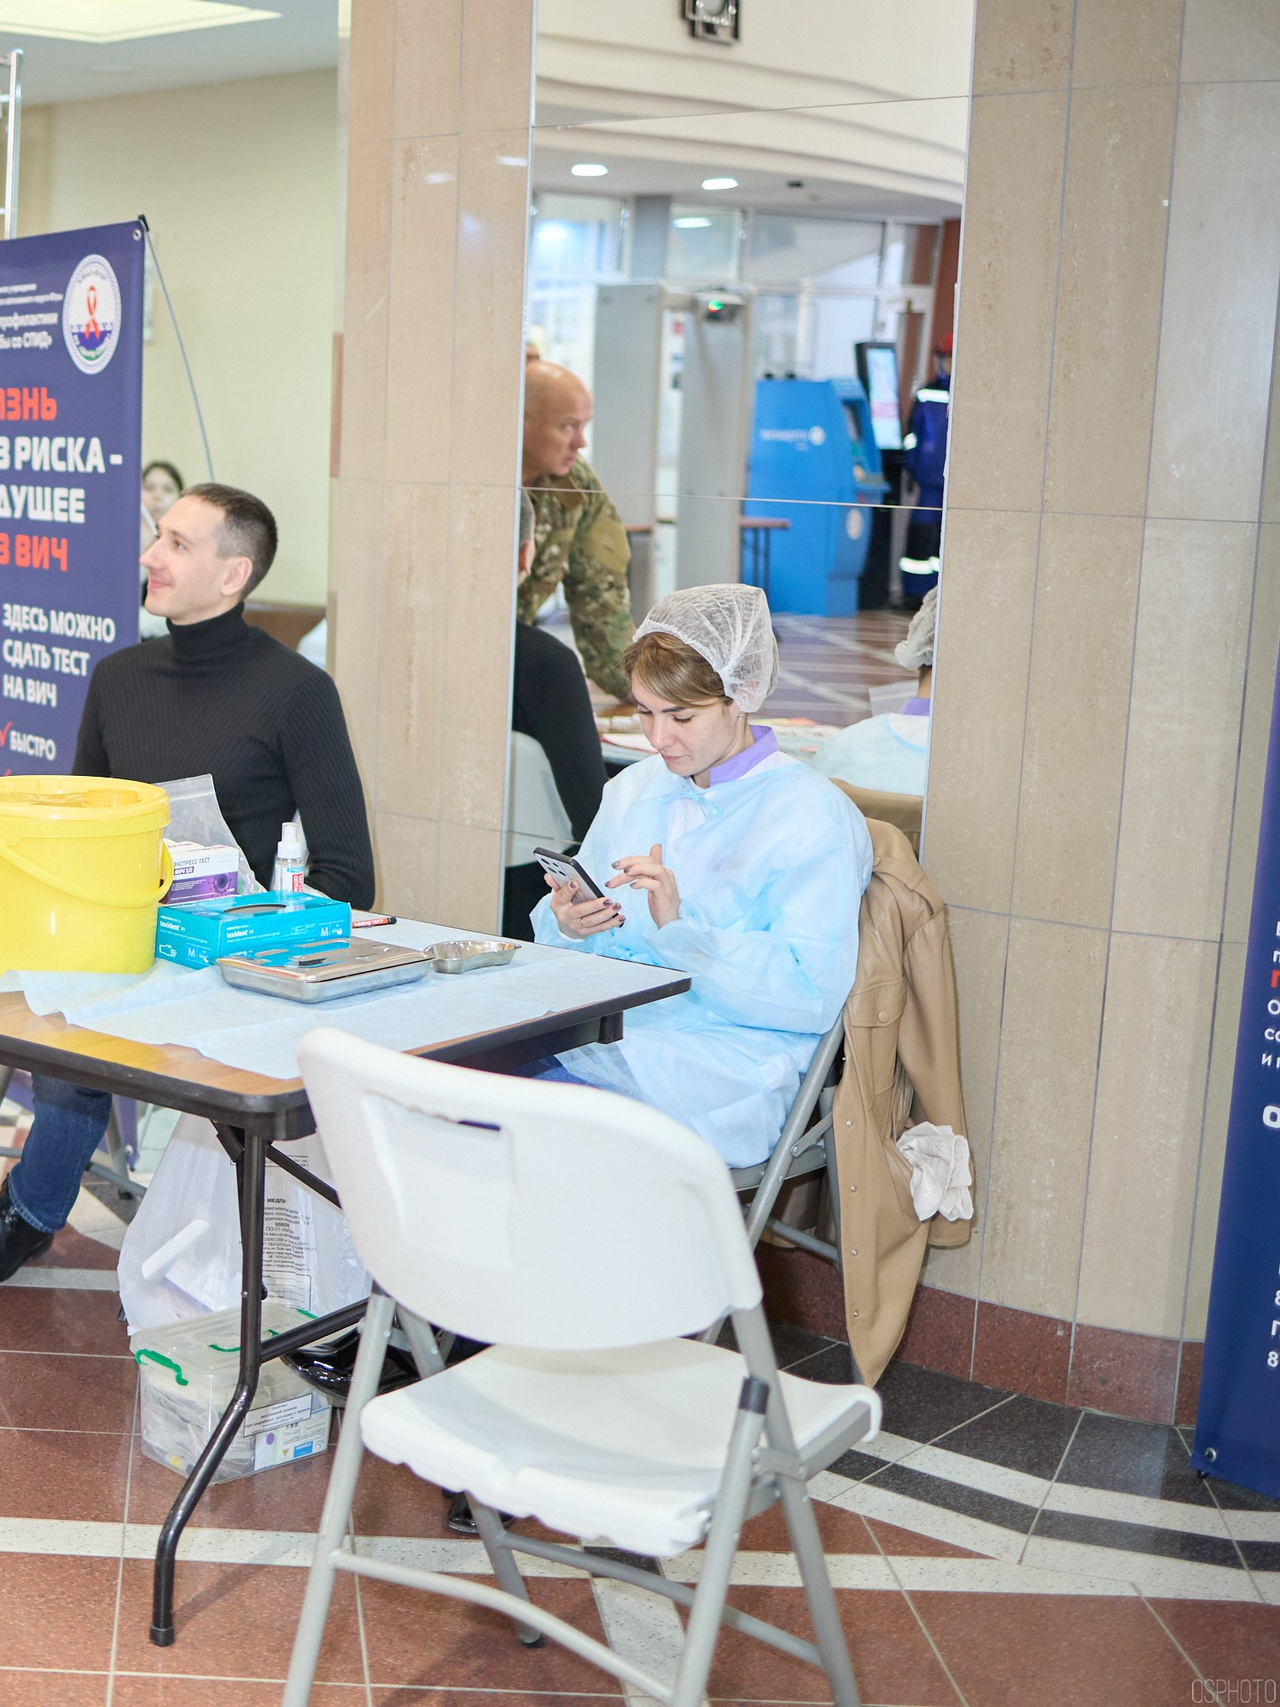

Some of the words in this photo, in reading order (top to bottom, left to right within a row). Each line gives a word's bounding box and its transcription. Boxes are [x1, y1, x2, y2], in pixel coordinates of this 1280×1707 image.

[14, 436, 106, 474] РИСКА
[15, 534, 68, 572] ВИЧ
[2, 603, 49, 633] ЗДЕСЬ
[50, 610, 116, 644] МОЖНО
[2, 639, 51, 670] СДАТЬ
[51, 646, 90, 677] ТЕСТ
[2, 674, 24, 700] НА
[26, 678, 57, 708] ВИЧ
[10, 730, 56, 762] БЫСТРО
